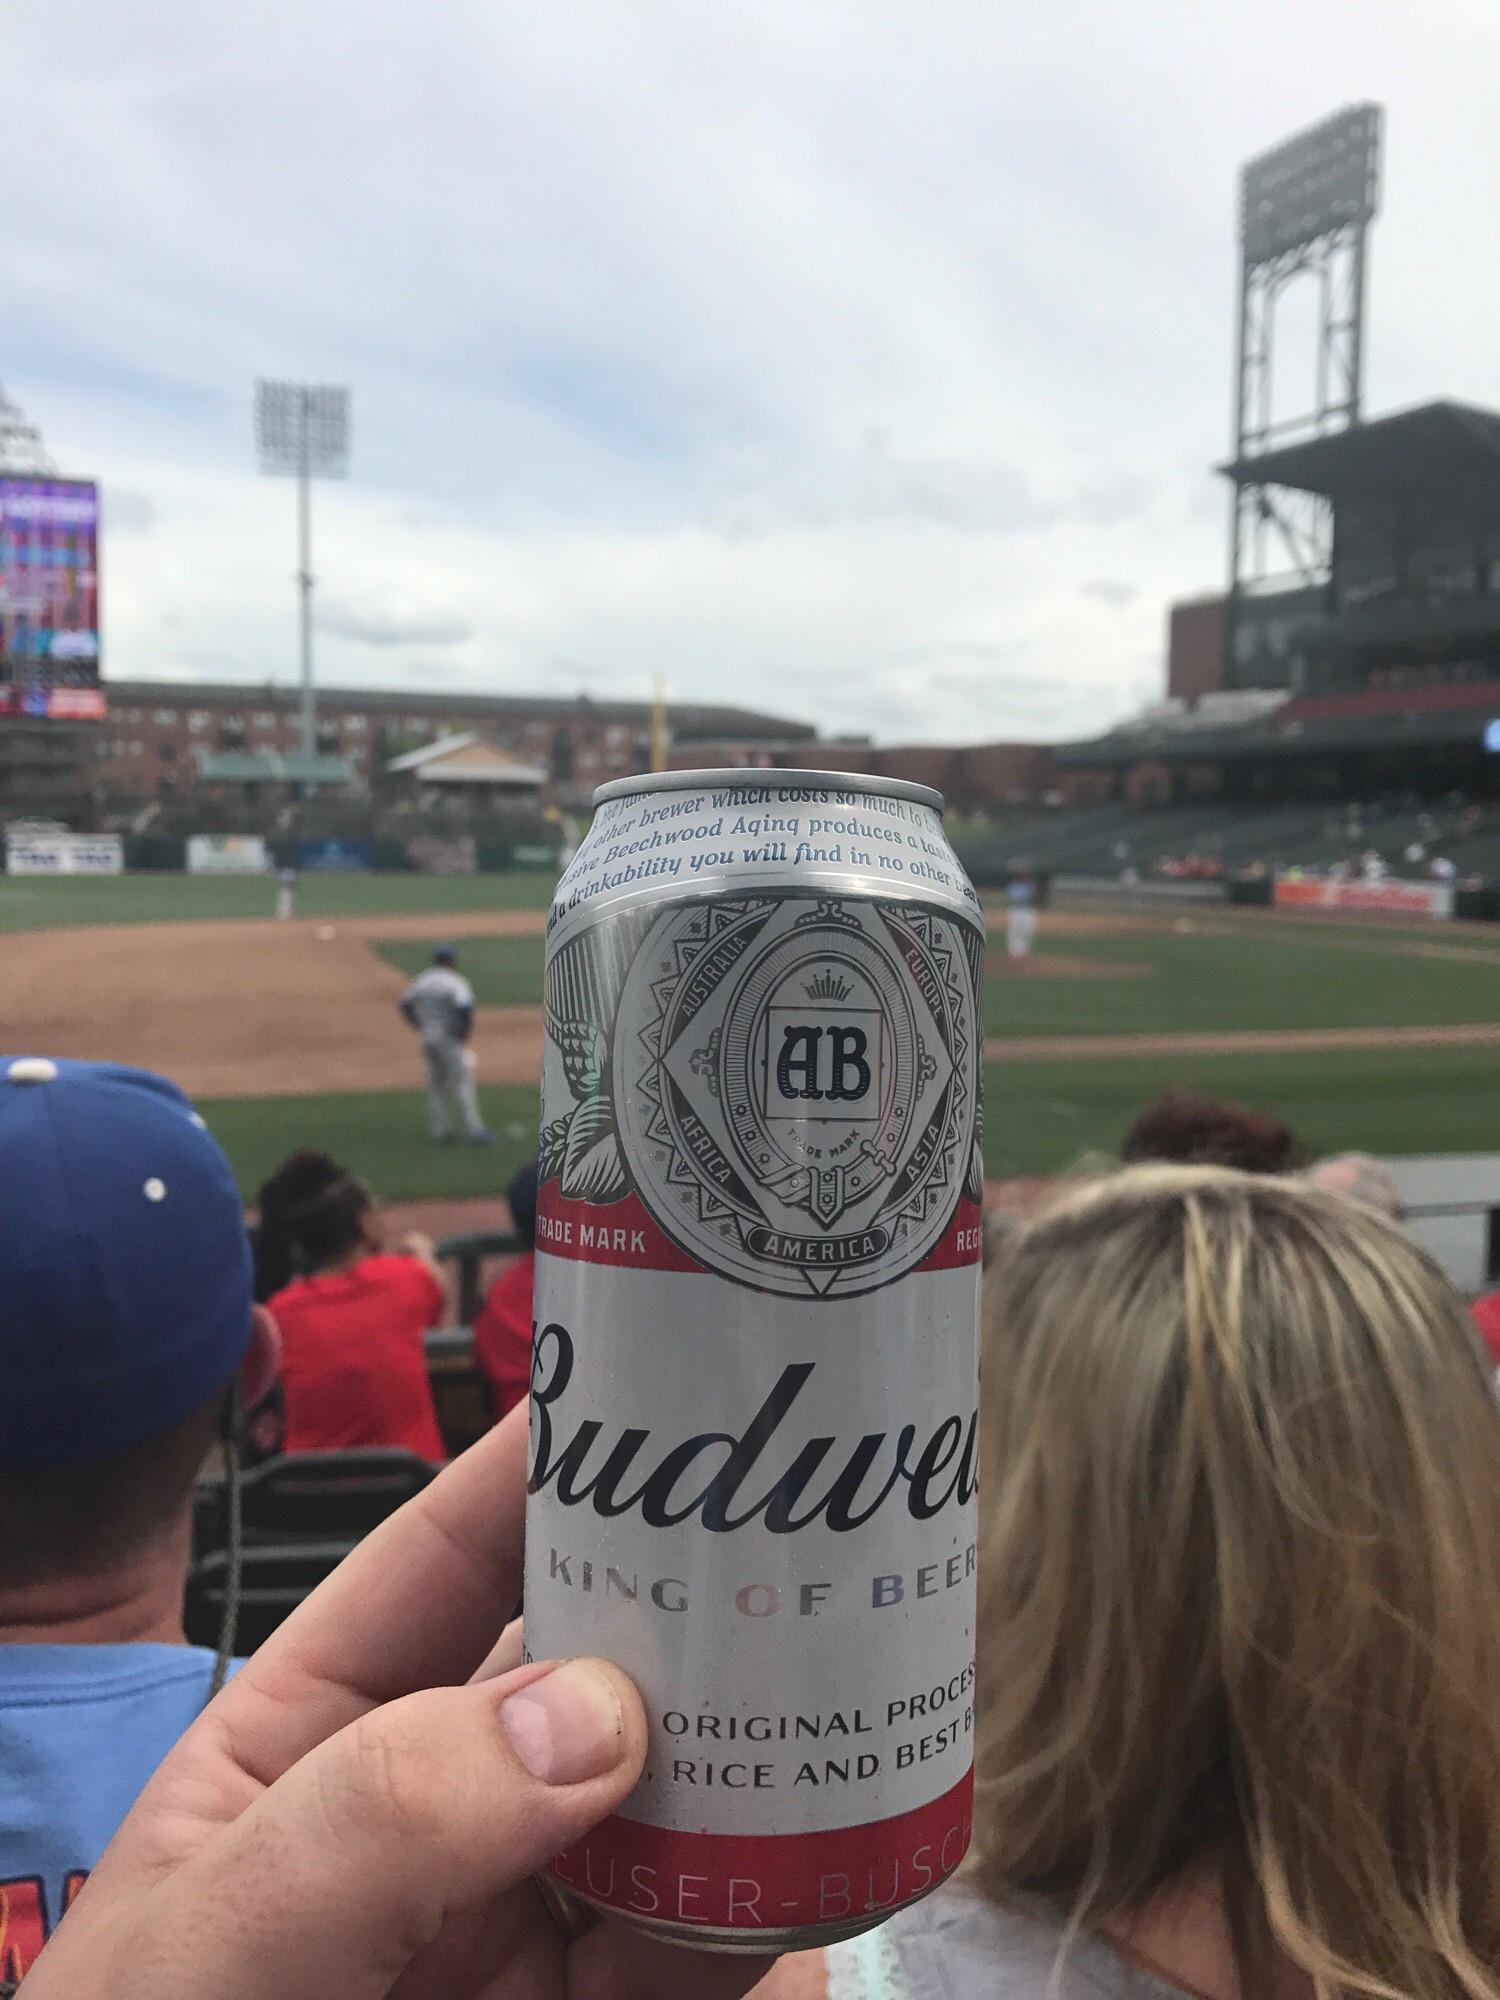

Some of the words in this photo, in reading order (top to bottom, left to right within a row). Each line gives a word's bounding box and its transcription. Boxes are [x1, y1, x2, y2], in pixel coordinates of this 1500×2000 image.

[593, 818, 635, 850] other
[639, 796, 704, 829] brewer
[712, 787, 771, 808] which
[778, 787, 829, 804] costs
[836, 791, 855, 806] so
[862, 794, 905, 820] much
[603, 817, 723, 865] Beechwood
[730, 813, 799, 837] Aging
[808, 817, 902, 845] produces
[907, 836, 917, 850] a
[559, 904, 567, 919] a
[569, 857, 682, 910] drinkability
[690, 850, 734, 873] you
[743, 842, 787, 863] will
[793, 842, 842, 865] find
[850, 846, 871, 866] in
[878, 854, 903, 871] no
[909, 860, 950, 886] other
[681, 934, 749, 1019] AUSTRALIA
[904, 947, 944, 1018] EUROPE
[776, 1025, 871, 1101] AB
[679, 1115, 732, 1184] AFRICA
[905, 1124, 941, 1182] ASIA
[538, 1215, 573, 1245] TRADE
[580, 1223, 646, 1254] MARK
[763, 1235, 877, 1261] AMERICA
[549, 1548, 689, 1613] KING
[735, 1582, 832, 1618] OF
[662, 1710, 873, 1741] ORIGINAL
[672, 1759, 776, 1789] RICE
[793, 1752, 881, 1788] AND
[895, 1718, 961, 1771] BEST
